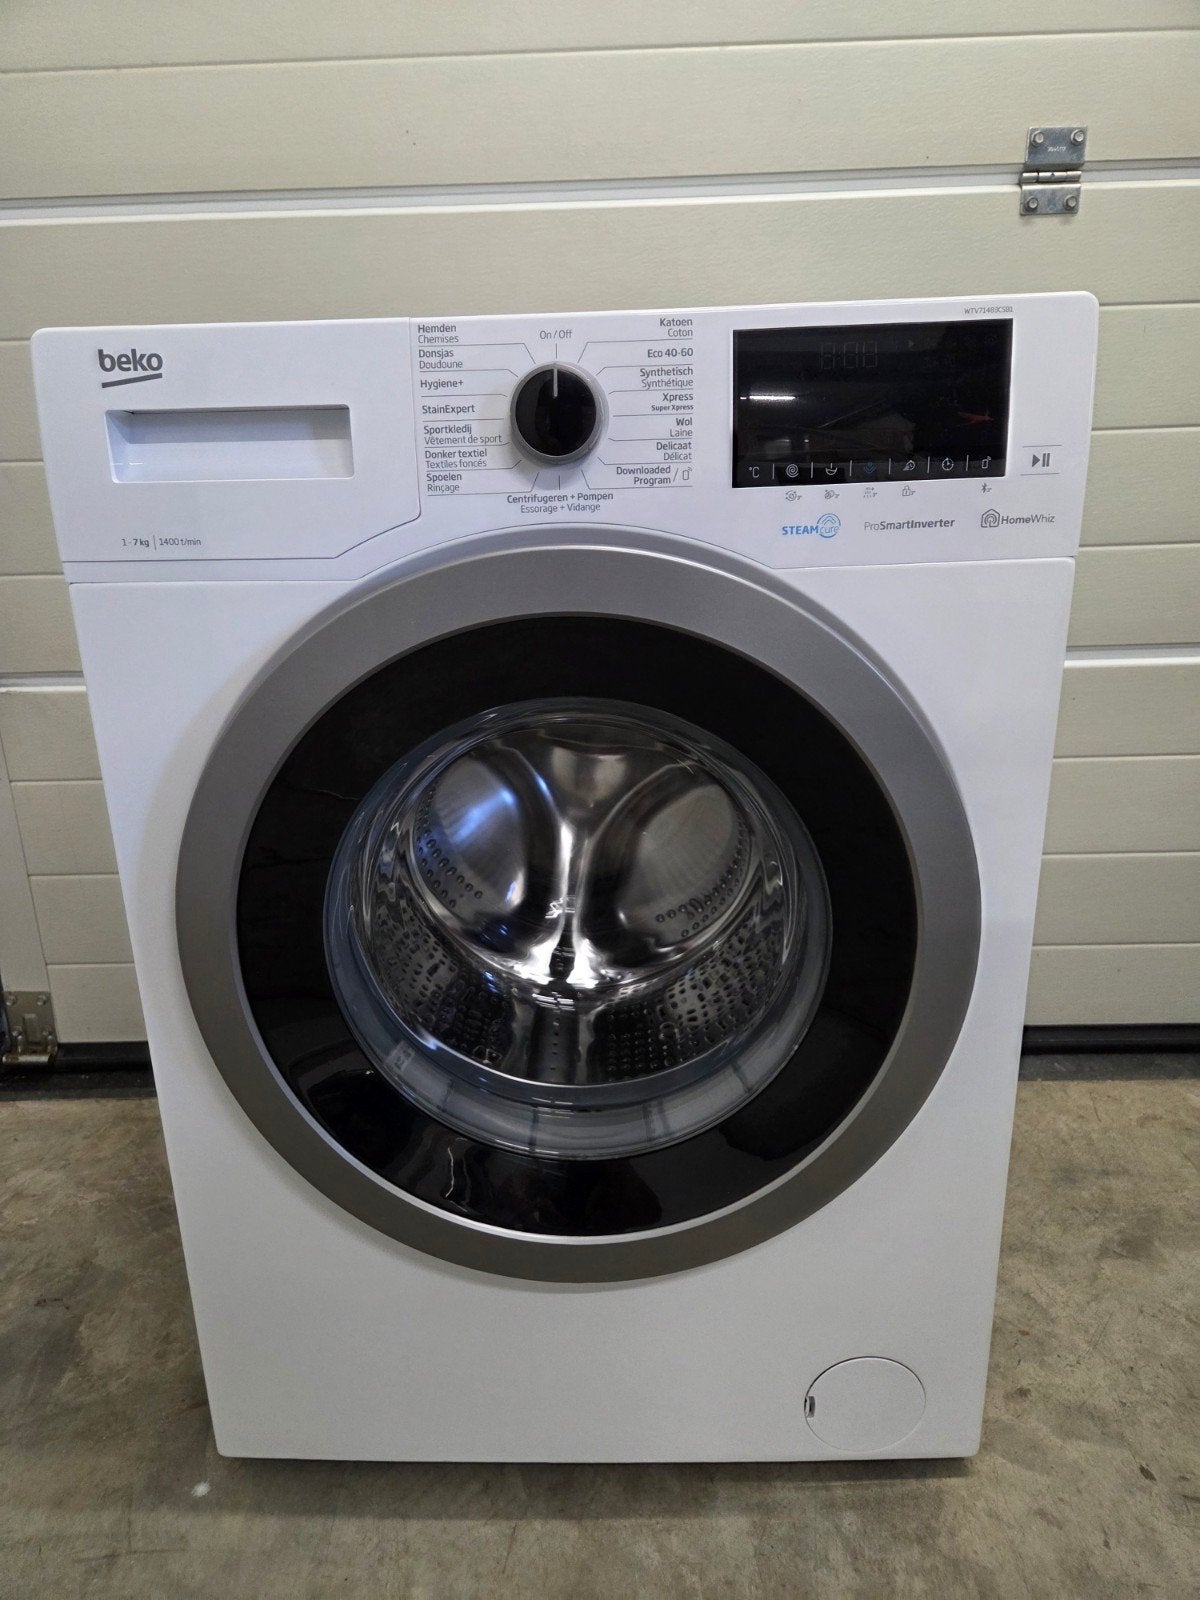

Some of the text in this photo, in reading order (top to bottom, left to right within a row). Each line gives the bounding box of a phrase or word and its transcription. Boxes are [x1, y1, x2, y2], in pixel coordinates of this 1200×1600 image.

[659, 318, 693, 327] Katoen
[417, 324, 457, 333] Hemden
[667, 328, 693, 337] Coton
[418, 334, 459, 343] Chemises
[539, 331, 552, 340] On
[558, 329, 573, 338] Off
[418, 349, 454, 359] Donsjas
[647, 348, 694, 358] Eco 40-60
[97, 348, 164, 372] beko
[419, 360, 463, 369] Doudoune
[640, 367, 694, 378] Synthetisch
[420, 379, 463, 390] Hygiene+
[641, 378, 694, 390] Synthétique
[662, 392, 694, 403] Xpress
[422, 404, 475, 415] StainExpert
[651, 404, 671, 412] Super
[675, 417, 693, 426] Wol
[423, 424, 472, 435] Sportkledij
[669, 429, 693, 437] Laine
[424, 434, 502, 445] Vêtement de sport
[656, 441, 692, 450] Delicaat
[424, 448, 487, 459] Donker textiel
[663, 452, 692, 461] Délicat
[425, 459, 487, 469] Textiles foncés
[616, 465, 671, 475] Downloaded
[426, 473, 462, 482] Spoelen
[633, 476, 671, 486] Program
[427, 484, 460, 493] Rinçage
[507, 494, 568, 504] Centrifugeren
[577, 493, 614, 502] Pompen
[520, 505, 557, 514] Essorage
[567, 504, 600, 512] Vidange
[1001, 514, 1055, 524] HomeWhiz
[864, 520, 955, 530] ProSmartInverter
[159, 538, 179, 546] 1400
